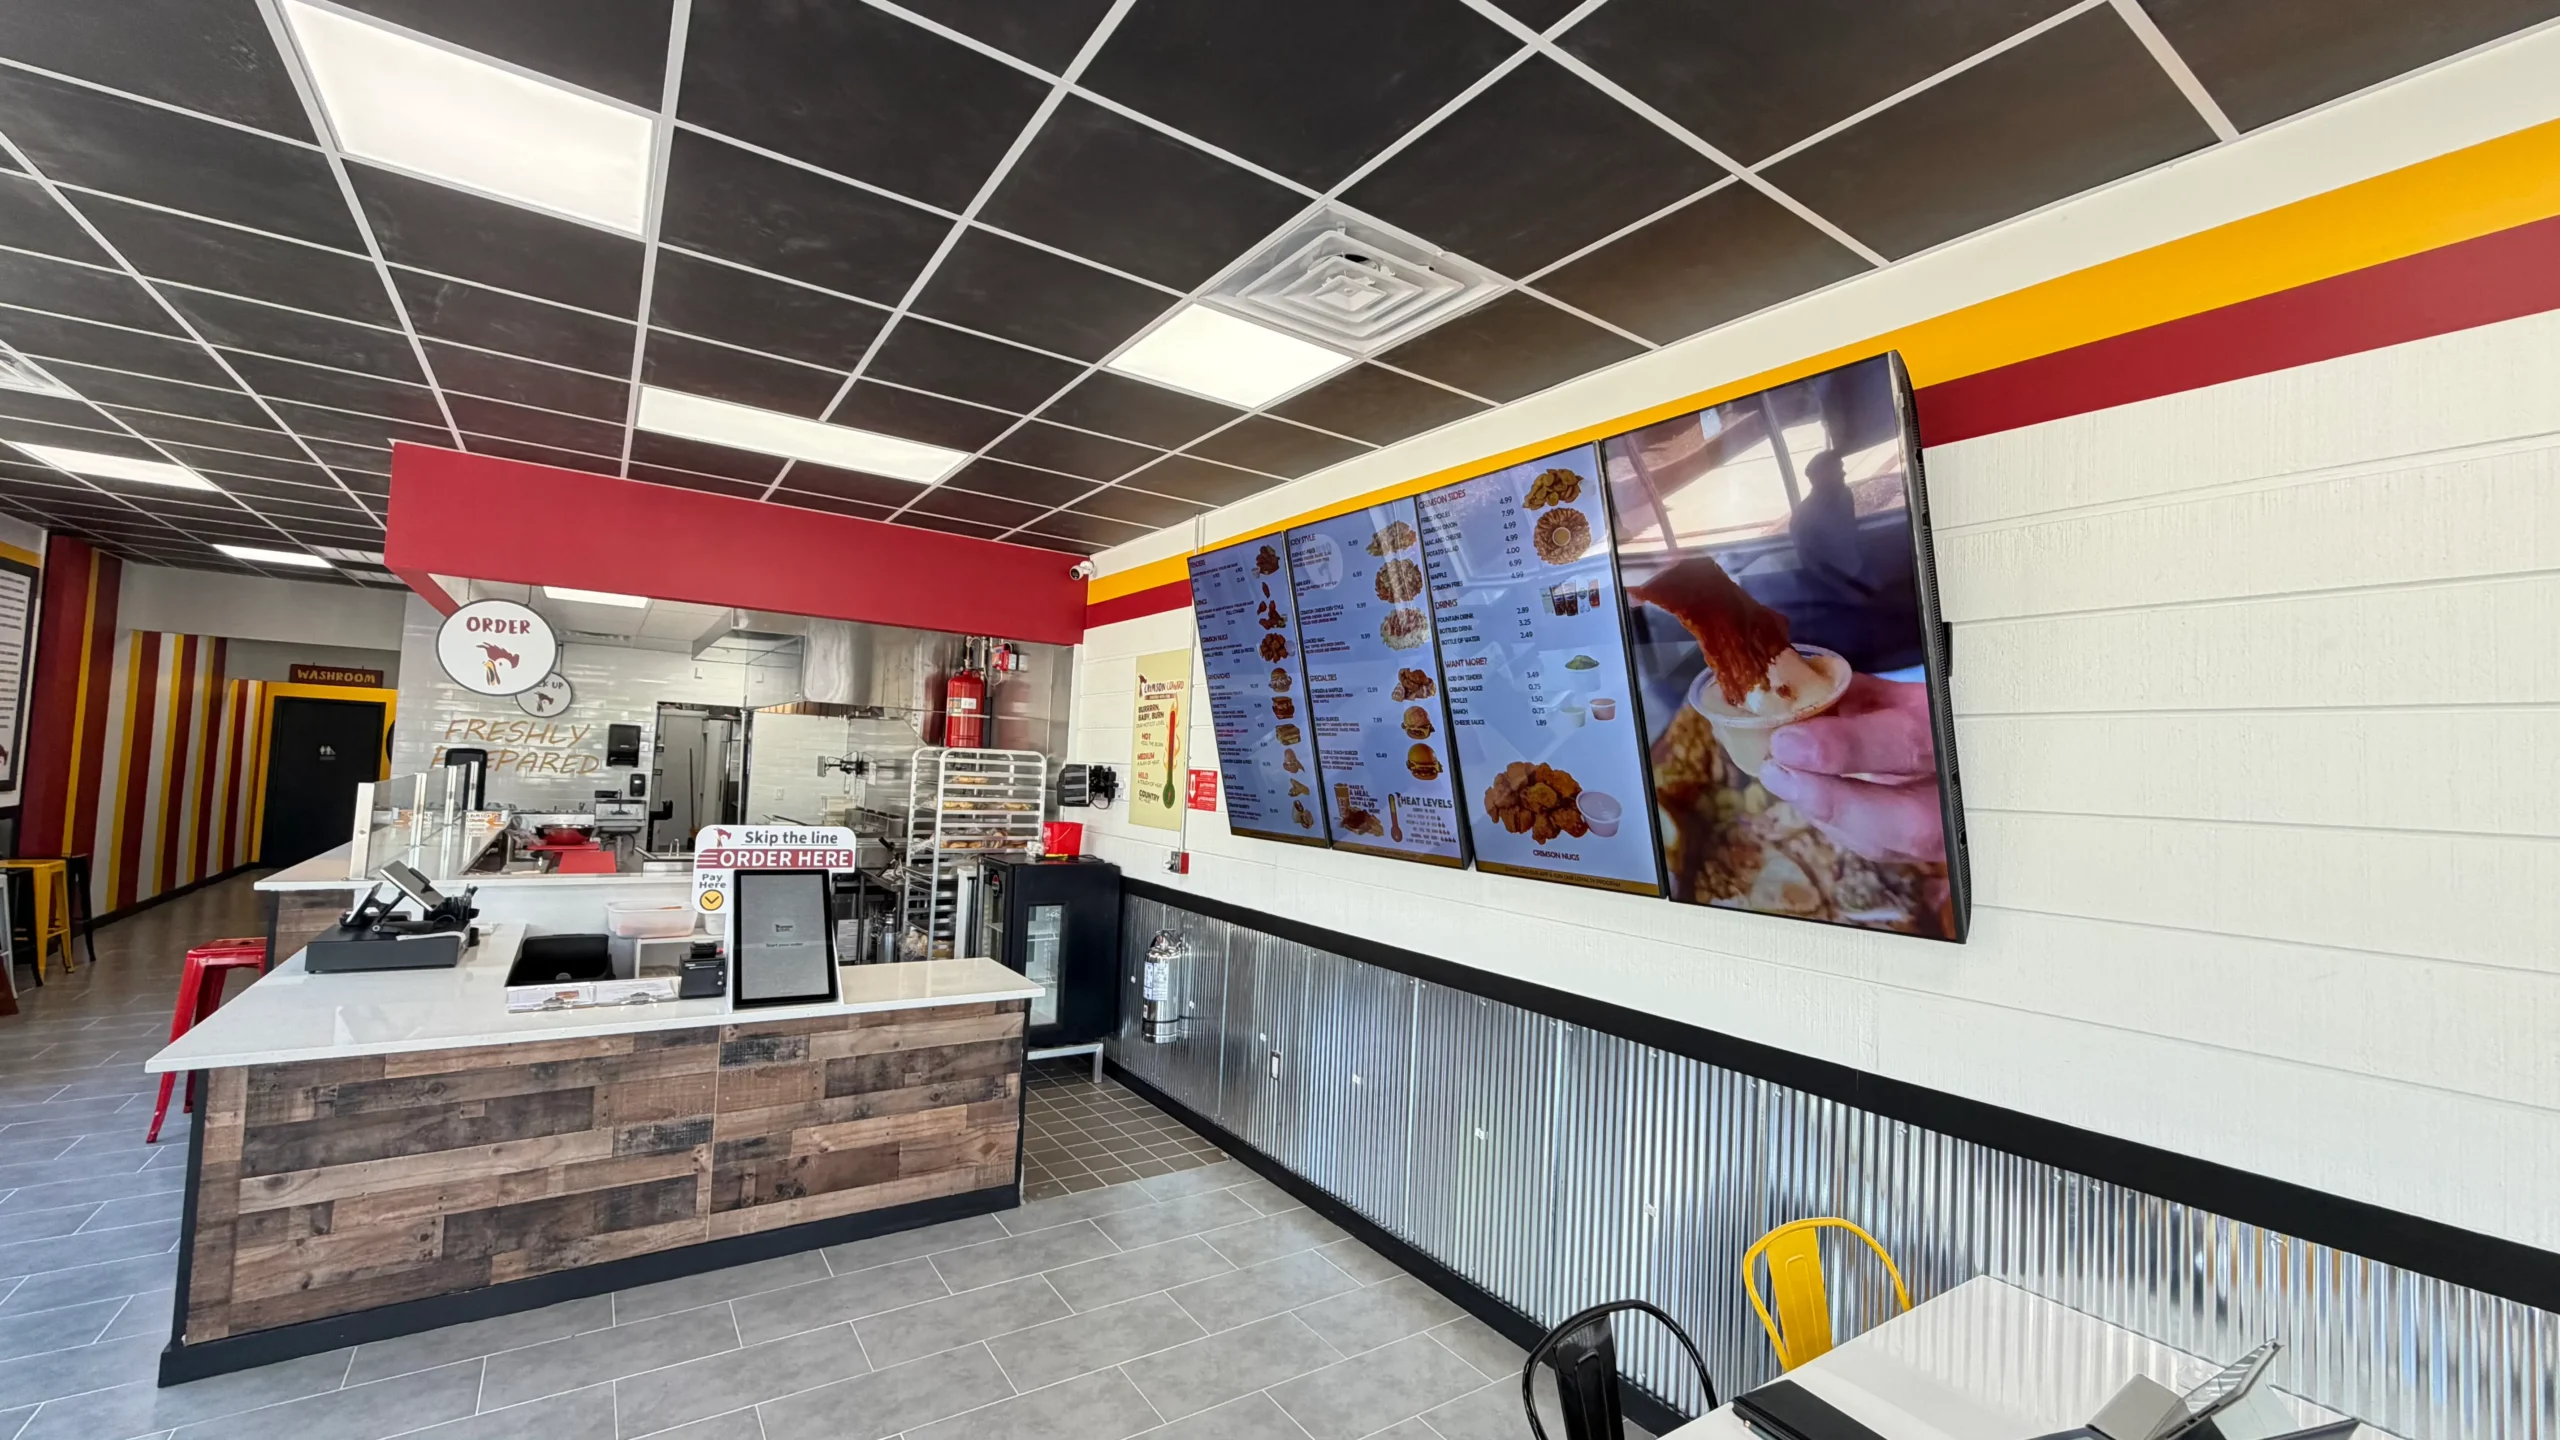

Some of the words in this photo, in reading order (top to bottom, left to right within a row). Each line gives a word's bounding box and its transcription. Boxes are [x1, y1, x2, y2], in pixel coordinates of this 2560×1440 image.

[1419, 495, 1447, 509] CRIMSON
[1448, 489, 1465, 501] SIDES
[1500, 496, 1512, 504] 4.99
[1502, 509, 1514, 517] 7.99
[1504, 521, 1516, 529] 4.99
[1506, 534, 1518, 542] 4.99
[1426, 549, 1444, 557] POTATO
[1509, 559, 1522, 567] 6.99
[1430, 572, 1447, 580] WAFFLE
[1511, 571, 1524, 579] 4.99
[1432, 583, 1451, 591] CRIMSON
[1435, 599, 1458, 610] DRINKS
[1516, 606, 1529, 614] 2.89
[1438, 615, 1459, 623] FOUNTAIN
[1519, 618, 1531, 626] 3.25
[466, 616, 530, 635] ORDER
[1444, 660, 1464, 668] WANT
[1465, 657, 1487, 666] MORE?
[297, 669, 376, 684] WASHROOM
[552, 681, 564, 690] UP
[444, 719, 591, 748] FRESHLY
[430, 745, 600, 775] PEPARED
[1137, 752, 1155, 760] MEDIUM
[1139, 789, 1159, 802] COUNTRY
[1401, 796, 1420, 806] HEAT
[1422, 797, 1452, 808] LEVELS
[745, 831, 778, 846] Skip
[782, 831, 807, 844] the
[811, 831, 838, 844] line
[720, 851, 791, 867] ORDER
[798, 851, 849, 867] HERE
[1533, 850, 1560, 860] CRIMSON
[1562, 853, 1580, 861] NUGS
[702, 874, 723, 882] Pay
[699, 881, 726, 889] Here
